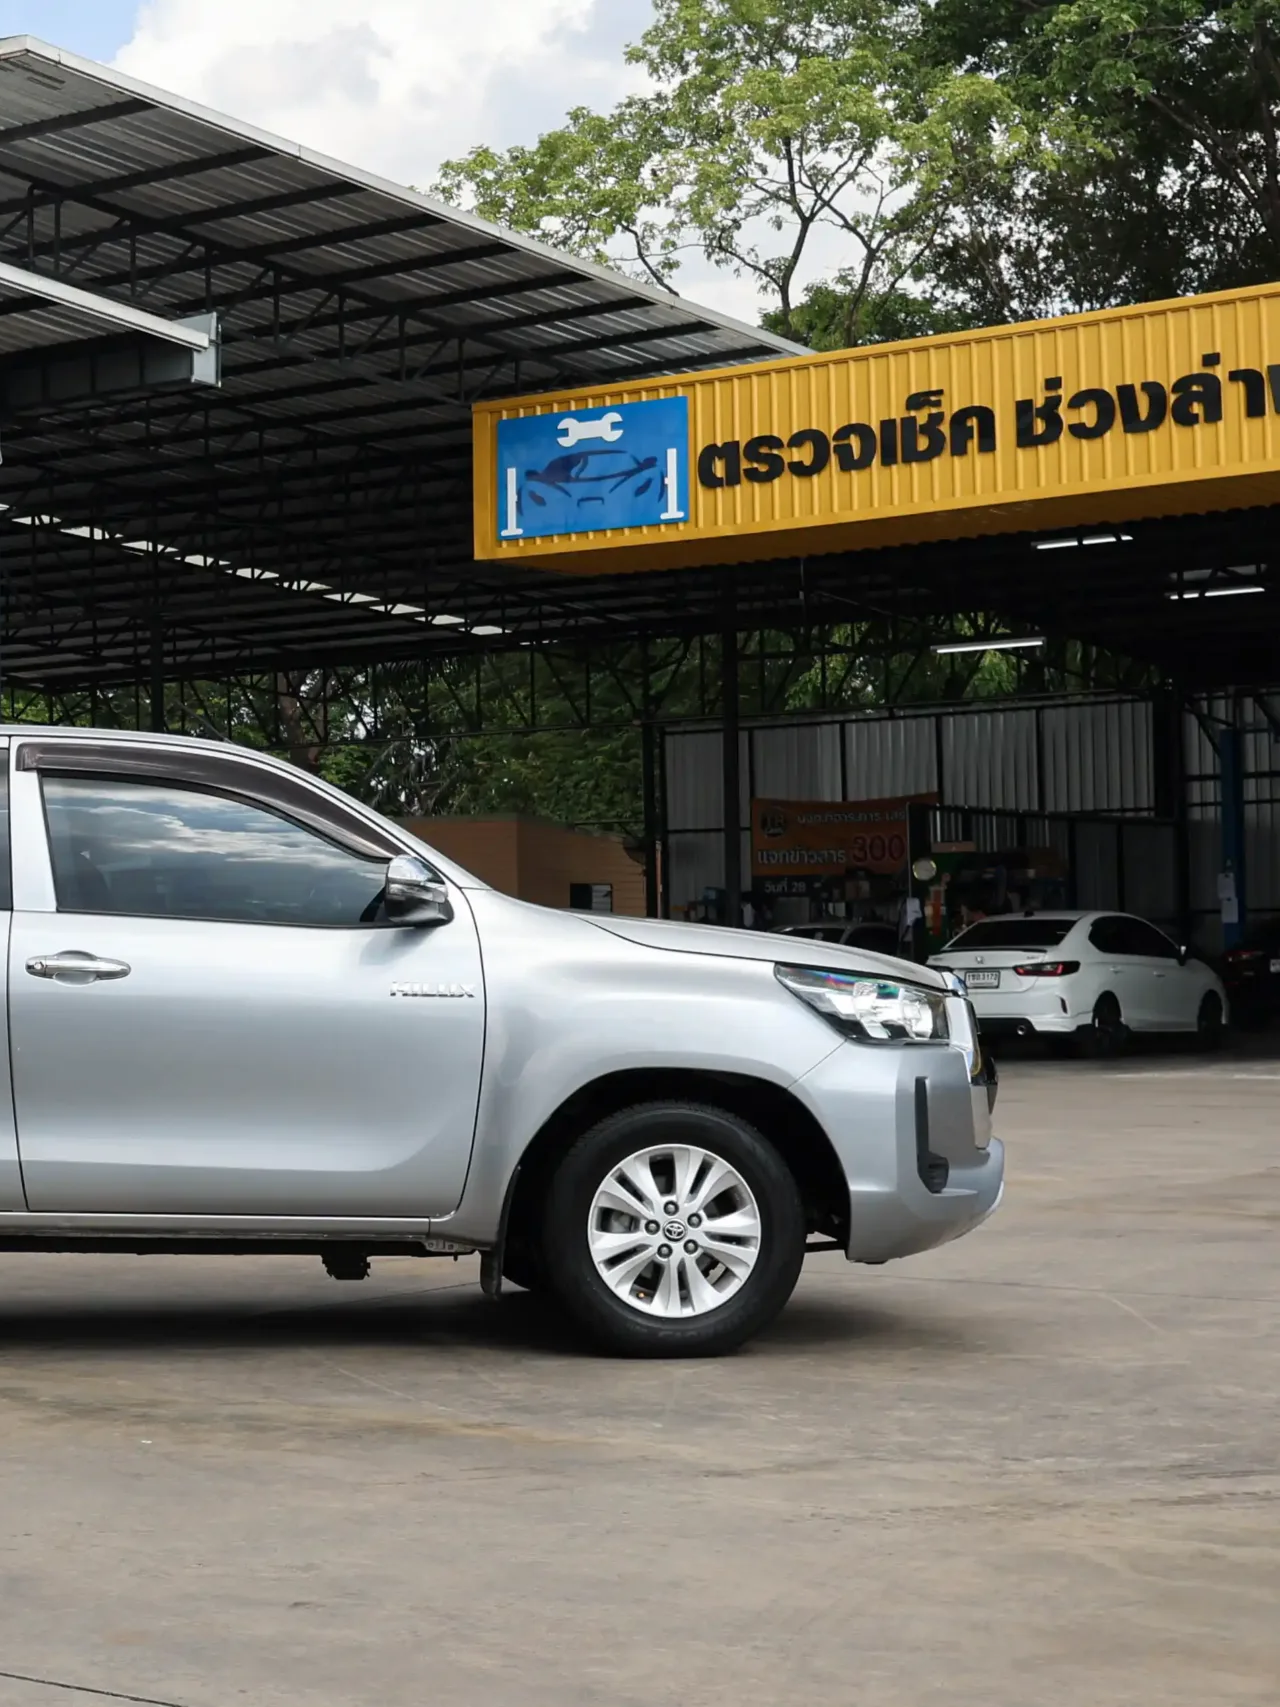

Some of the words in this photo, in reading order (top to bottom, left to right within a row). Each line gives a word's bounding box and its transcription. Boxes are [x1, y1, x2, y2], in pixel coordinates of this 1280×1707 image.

[697, 388, 997, 488] ตรวจเช็ค
[757, 845, 847, 865] แจกข้าวสาร
[852, 834, 906, 863] 300
[390, 981, 477, 998] HILUX
